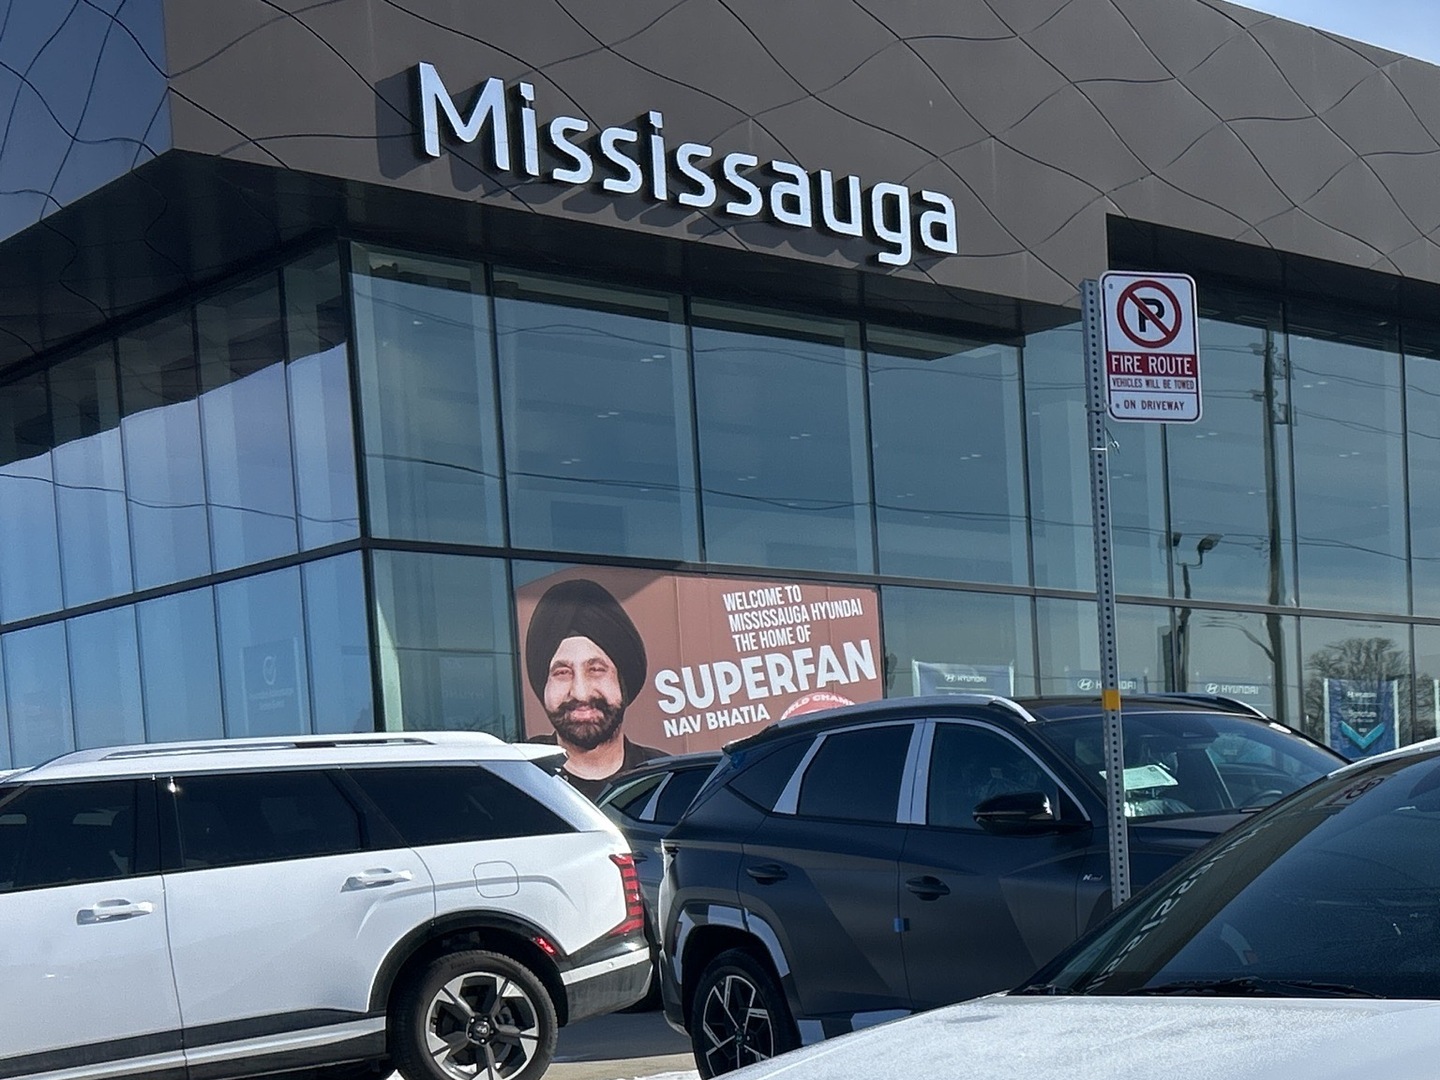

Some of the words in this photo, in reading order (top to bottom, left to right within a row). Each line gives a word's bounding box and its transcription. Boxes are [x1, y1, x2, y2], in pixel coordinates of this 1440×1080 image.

[418, 61, 958, 266] Mississauga
[1111, 355, 1143, 373] FIRE
[1148, 356, 1193, 375] ROUTE
[1112, 378, 1143, 388] VEHICLES
[1146, 379, 1161, 389] WILL
[1163, 379, 1172, 389] BE
[1174, 380, 1194, 390] TOWED
[1124, 400, 1136, 409] ON
[1141, 400, 1185, 411] DRIVEWAY
[723, 587, 785, 612] WELCOME
[785, 584, 802, 603] TO
[728, 604, 810, 632] MISSISSAUGA
[810, 598, 863, 621] HYUNDAI
[732, 632, 759, 652] THE
[759, 627, 795, 649] HOME
[796, 625, 811, 643] OF
[655, 639, 877, 714] SUPERFAN
[1221, 686, 1258, 695] HYUNDAI
[663, 714, 701, 738] NAV
[706, 703, 771, 730] BHATIA
